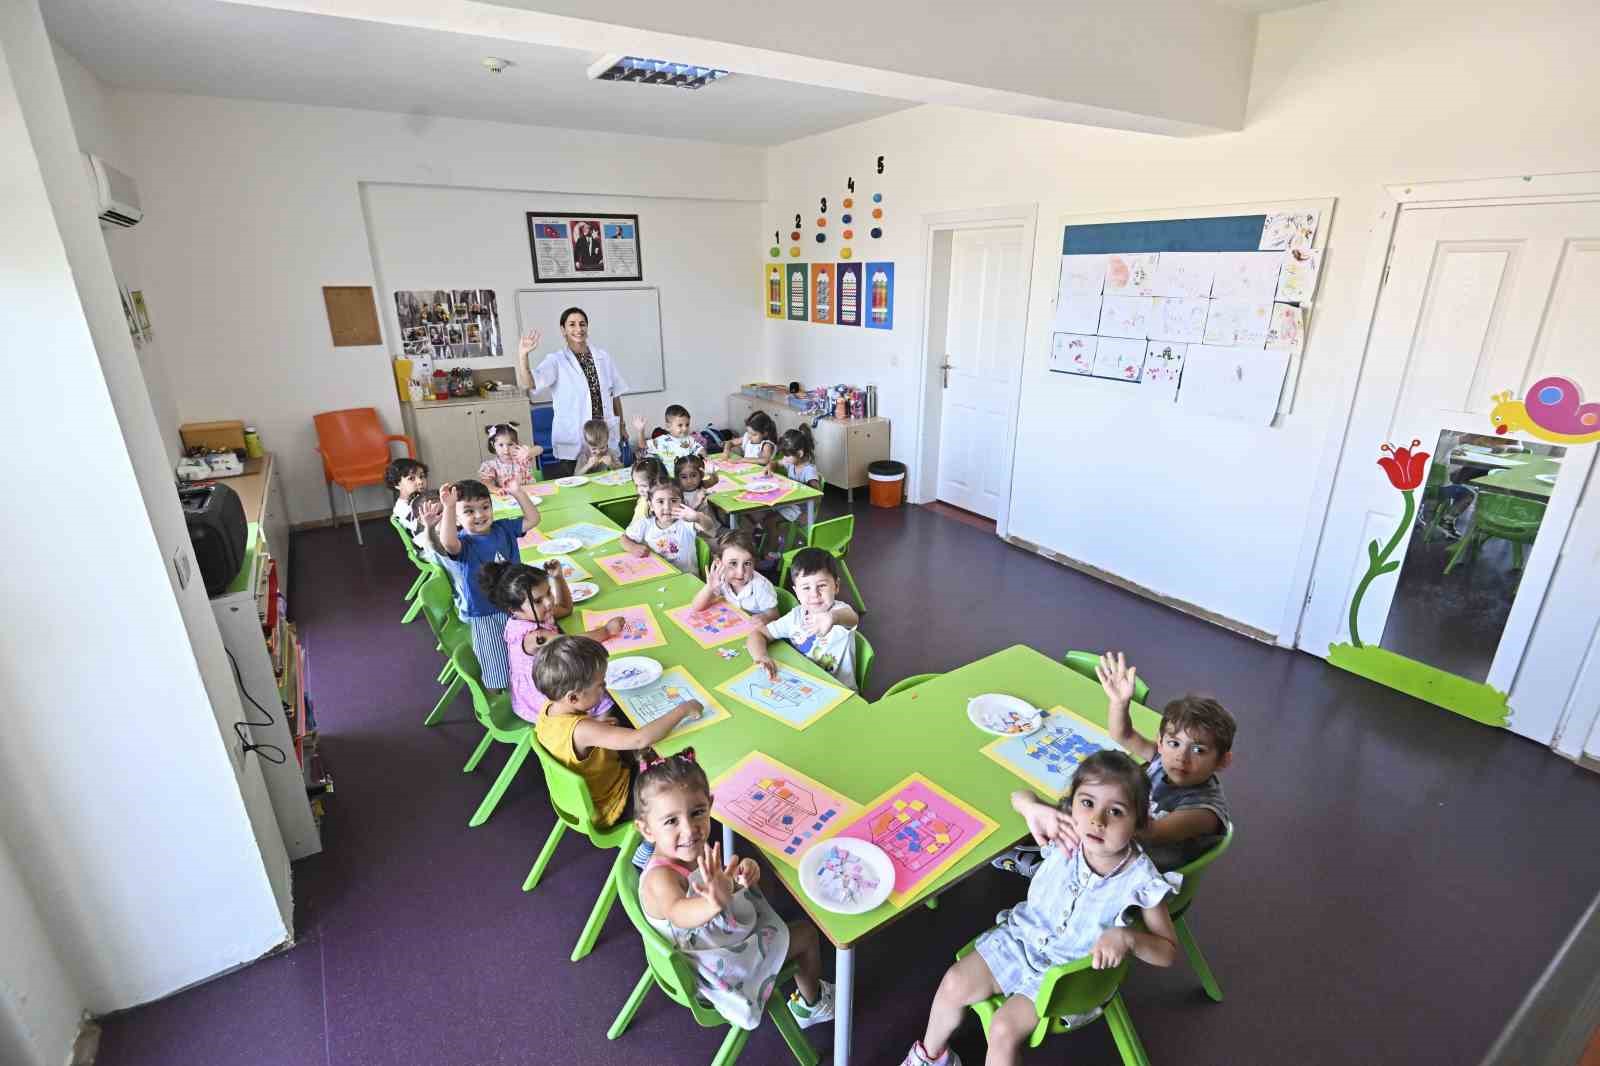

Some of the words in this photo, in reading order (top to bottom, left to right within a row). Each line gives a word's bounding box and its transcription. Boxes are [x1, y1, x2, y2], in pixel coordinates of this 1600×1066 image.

[877, 155, 884, 174] 5
[847, 177, 855, 193] 4
[820, 197, 827, 213] 3
[795, 213, 802, 229] 2
[775, 231, 780, 244] 1
